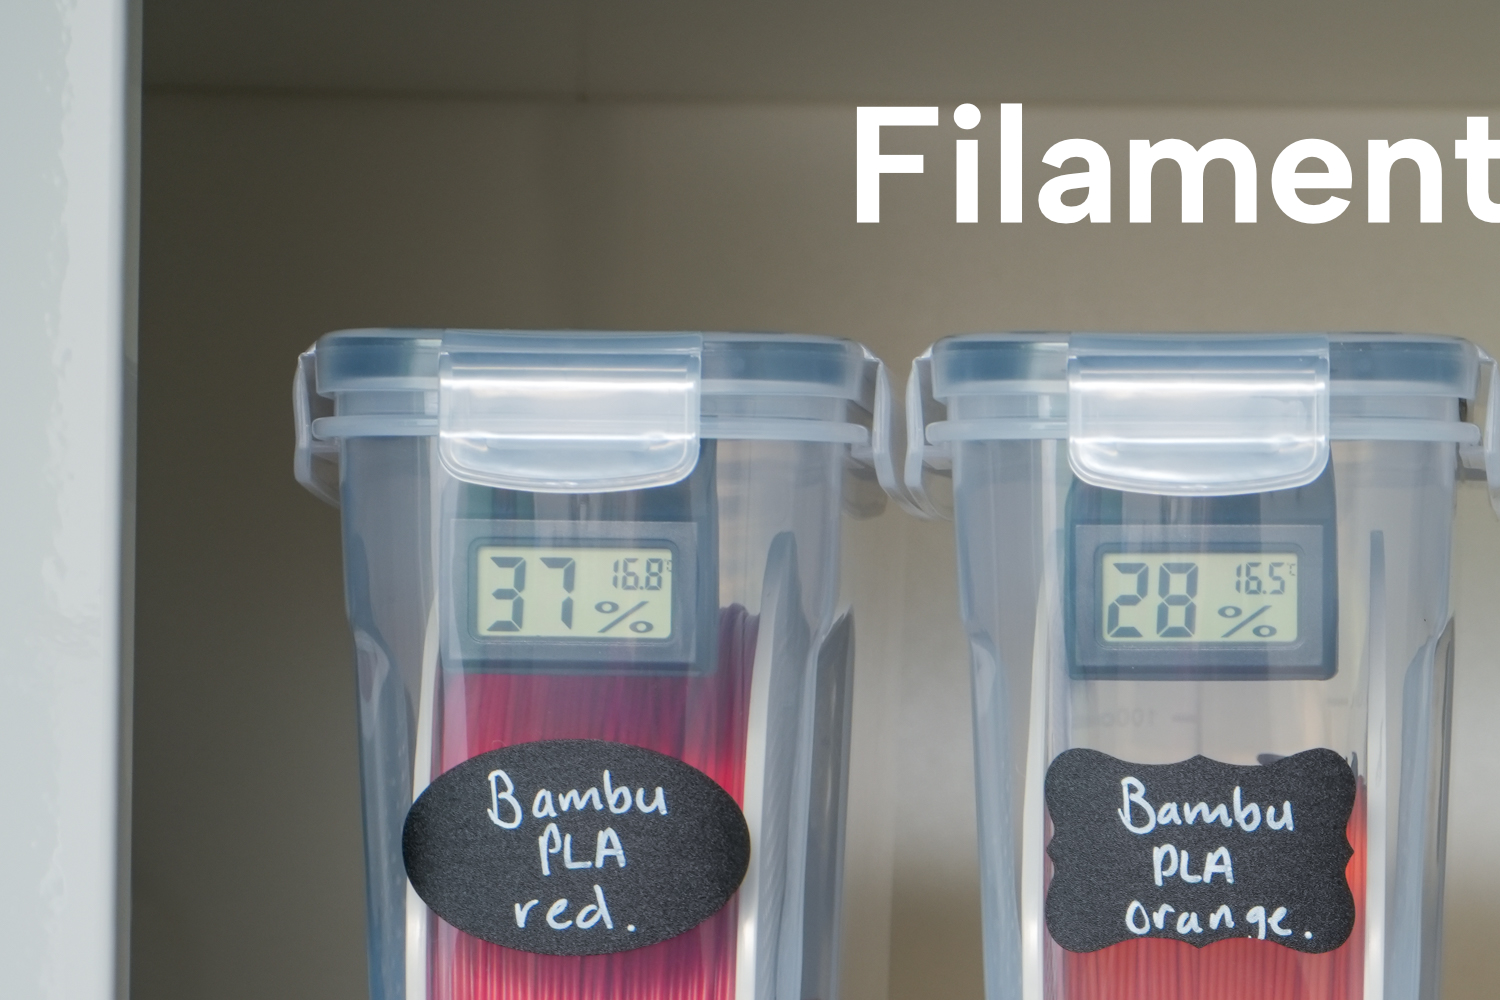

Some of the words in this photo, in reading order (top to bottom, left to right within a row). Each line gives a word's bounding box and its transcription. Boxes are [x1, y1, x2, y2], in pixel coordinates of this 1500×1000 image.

[487, 770, 667, 829] Bambu
[1118, 777, 1294, 834] Bambu
[538, 823, 627, 876] PLA
[1153, 844, 1235, 887] PLA
[514, 884, 636, 932] red.
